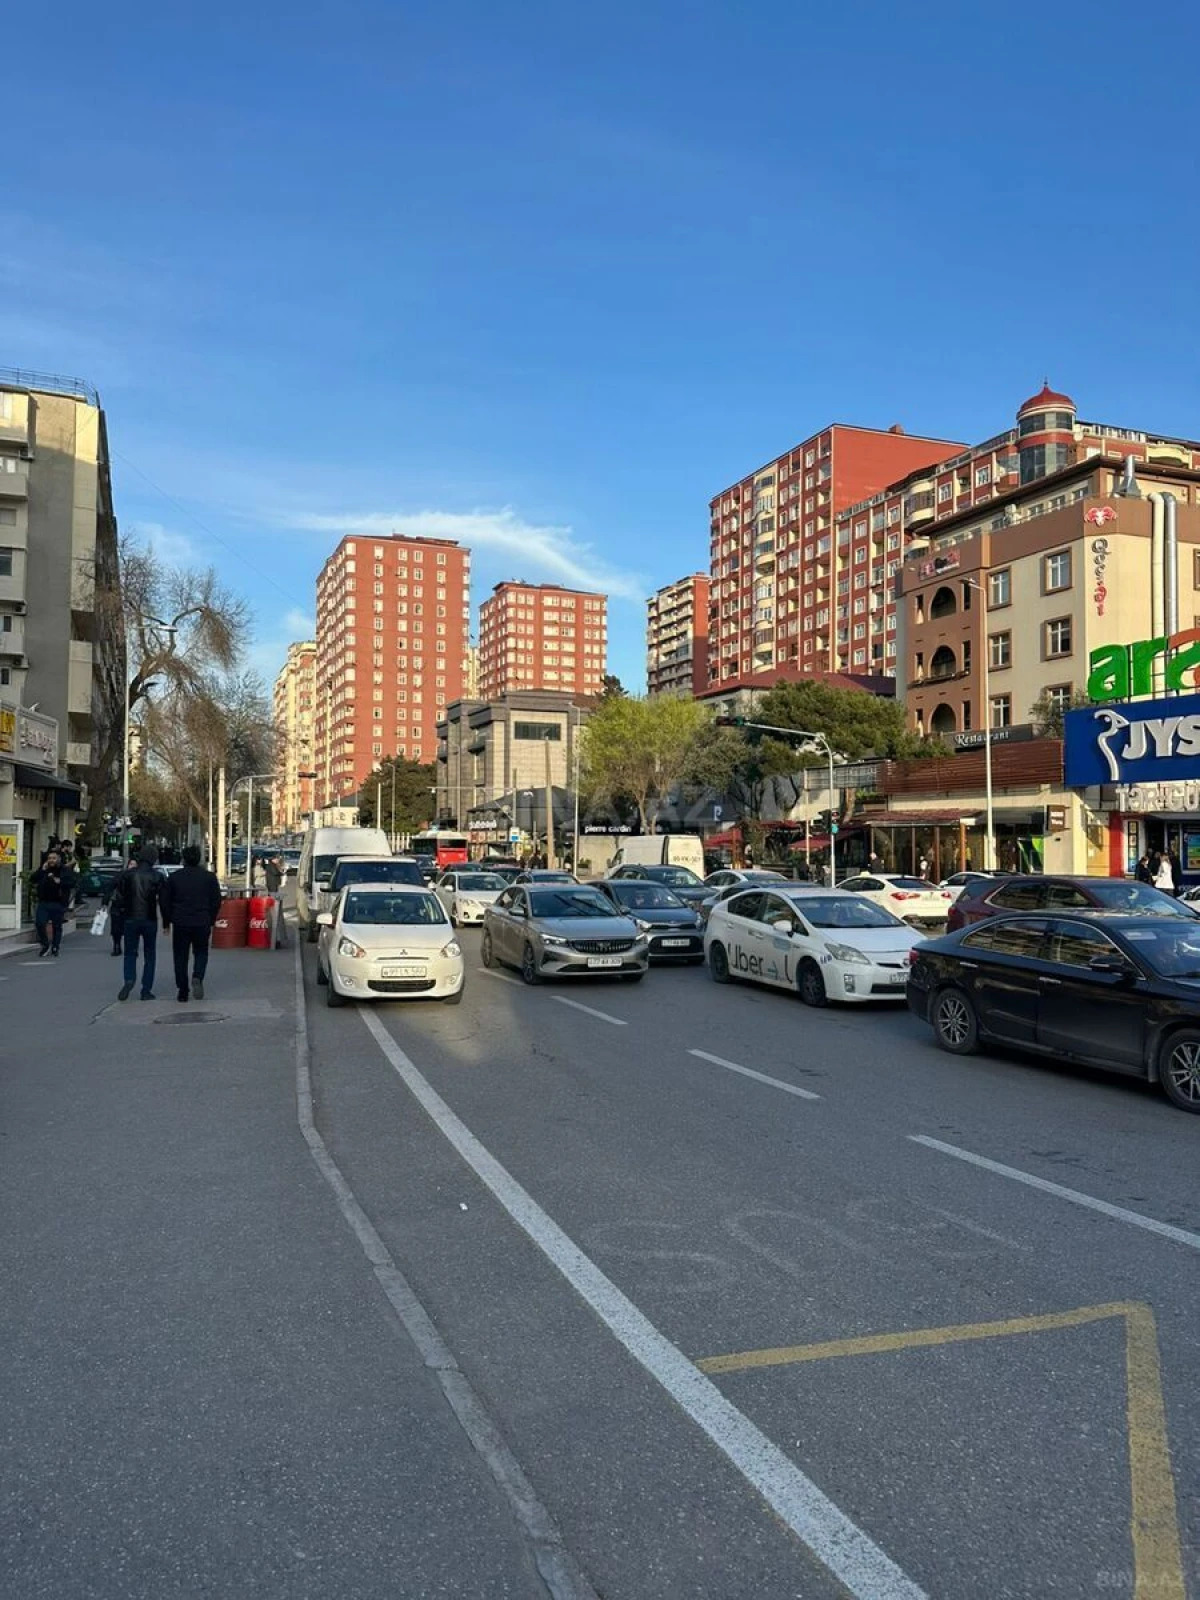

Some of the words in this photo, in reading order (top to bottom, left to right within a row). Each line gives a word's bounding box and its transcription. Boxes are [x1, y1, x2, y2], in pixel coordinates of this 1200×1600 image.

[585, 825, 607, 833] pierre
[608, 825, 632, 833] cardin
[727, 943, 764, 977] Uber
